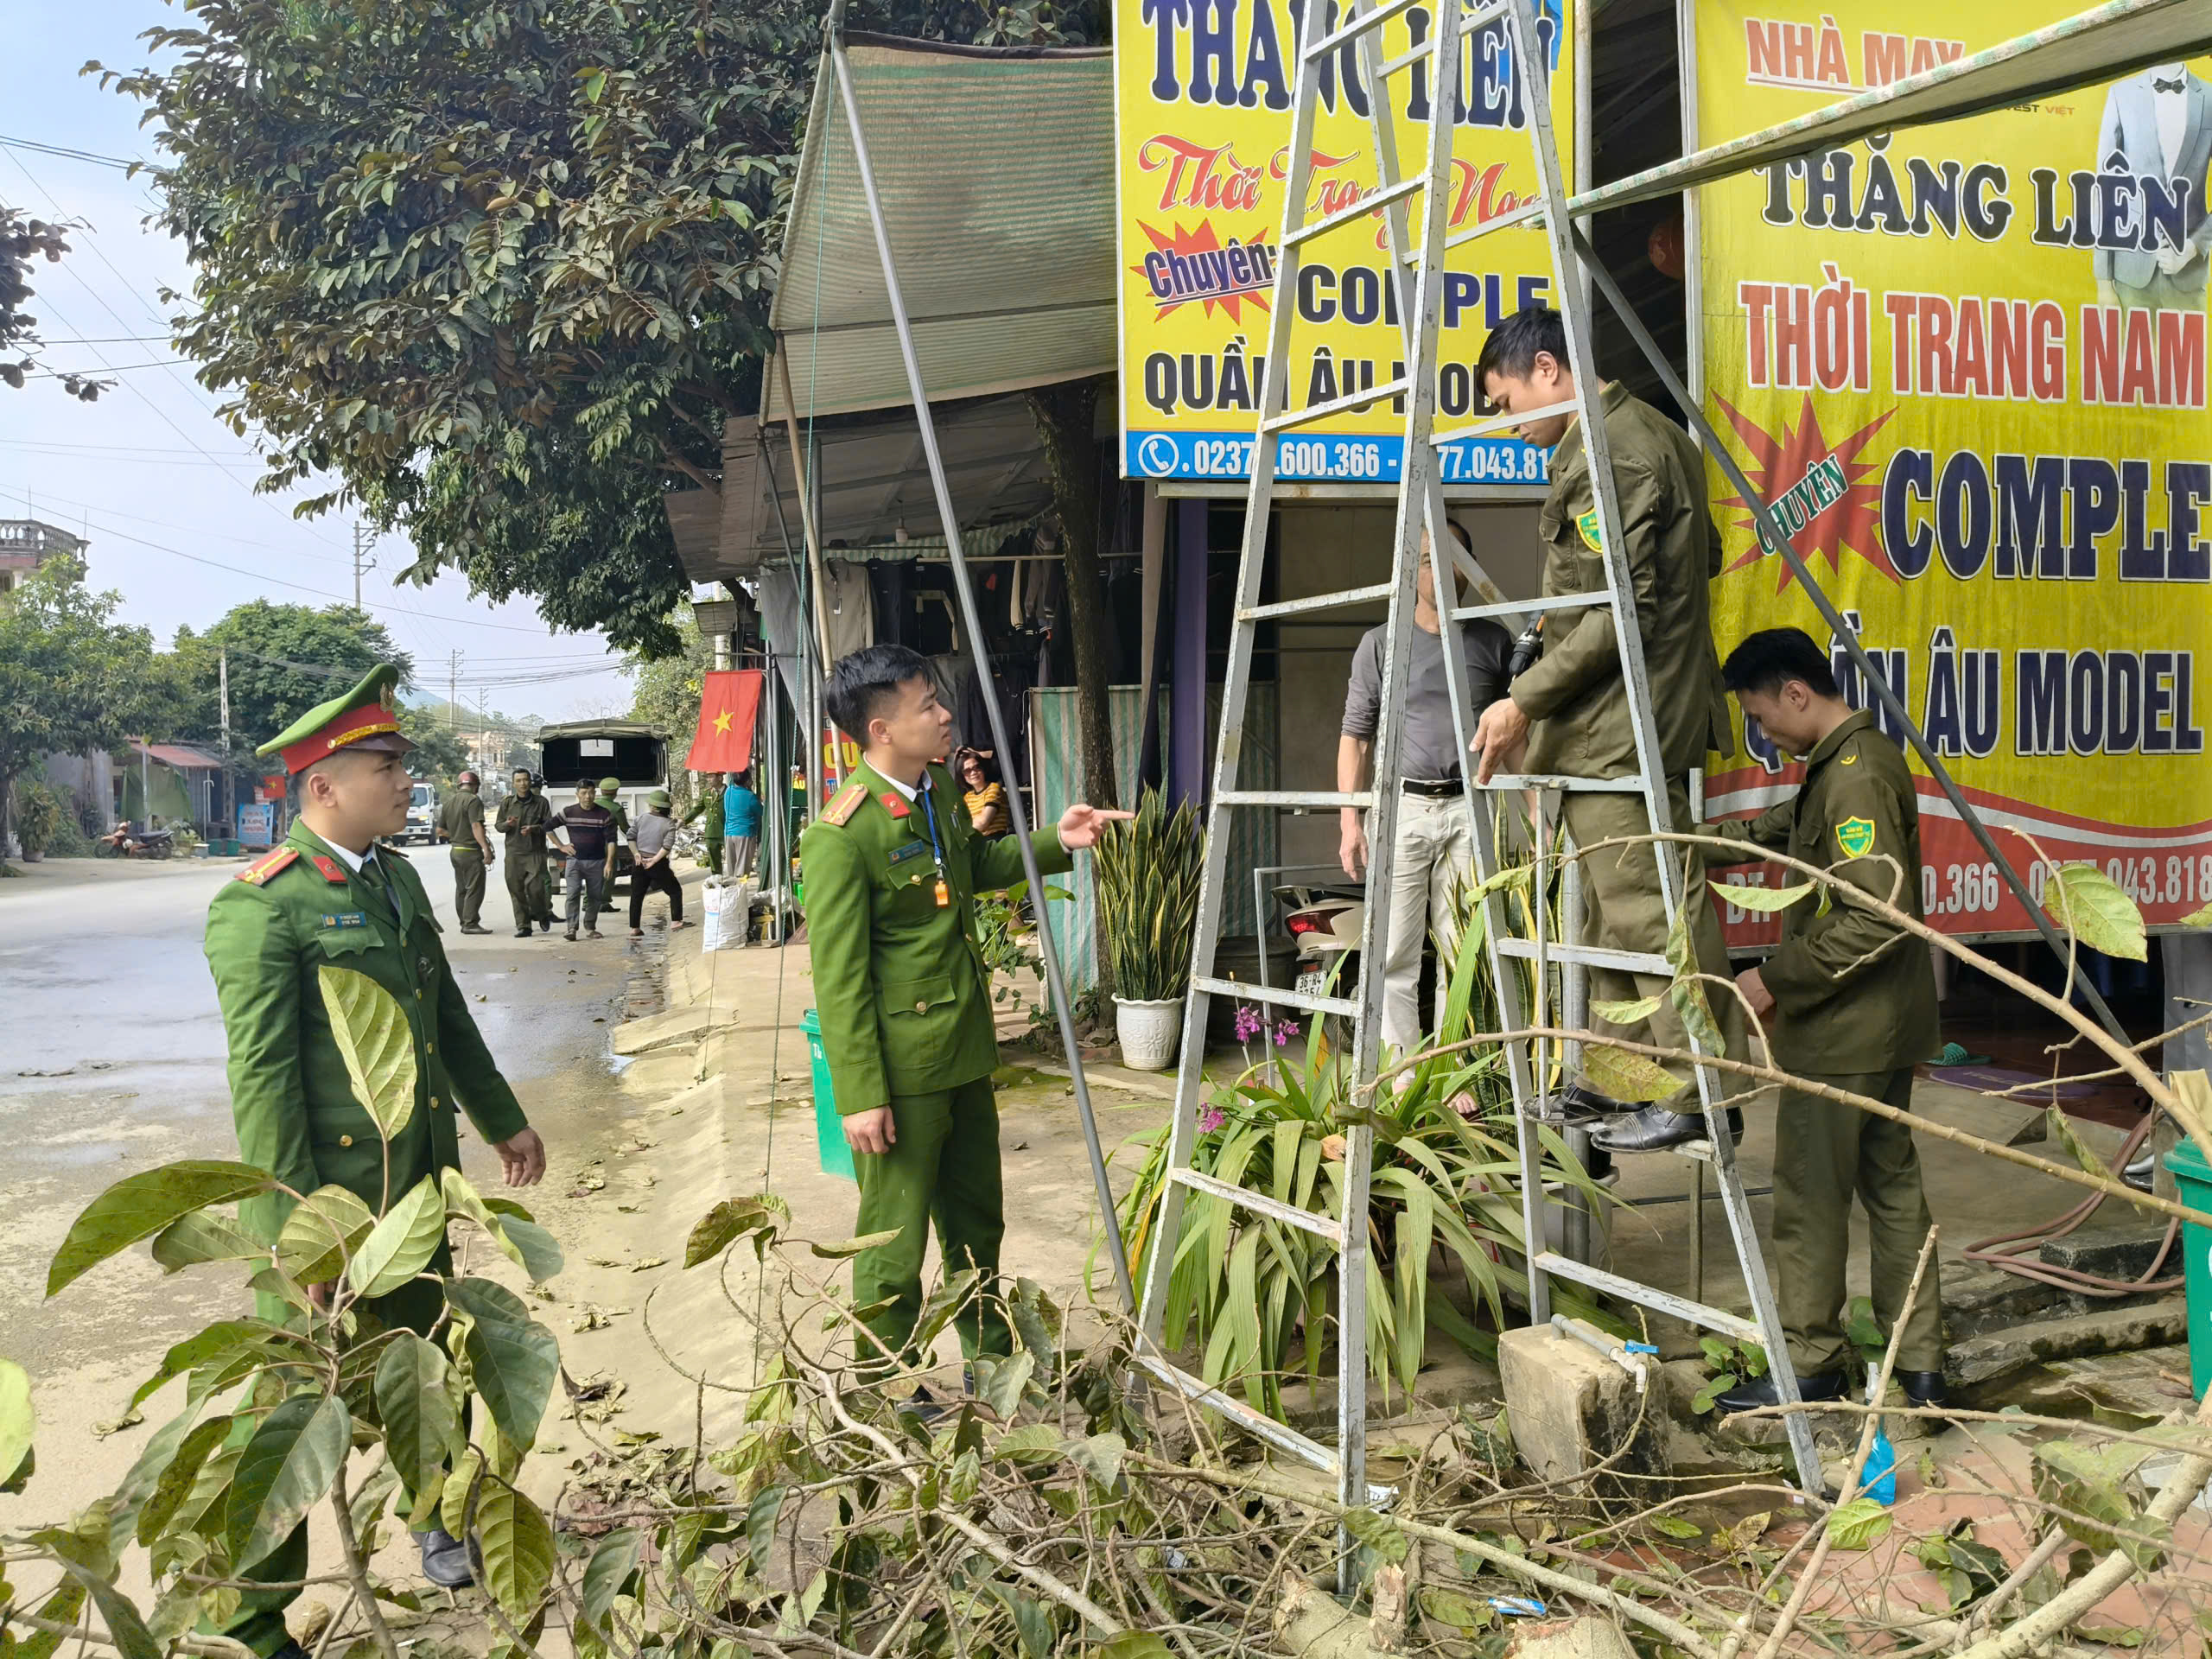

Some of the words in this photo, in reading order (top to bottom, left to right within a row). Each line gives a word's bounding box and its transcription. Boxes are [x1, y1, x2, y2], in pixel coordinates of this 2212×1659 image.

[1745, 15, 1851, 86] NHÀ
[1138, 134, 1264, 213] Thời
[2029, 149, 2192, 257] LIÊN
[1306, 346, 1374, 414] ÂU
[1738, 261, 1872, 393] THỜI
[1884, 290, 2067, 404] TRANG
[2080, 303, 2208, 410] NAM
[1881, 447, 2212, 582] COMPLE
[1923, 625, 2002, 759] ÂU
[2015, 647, 2205, 757] MODEL
